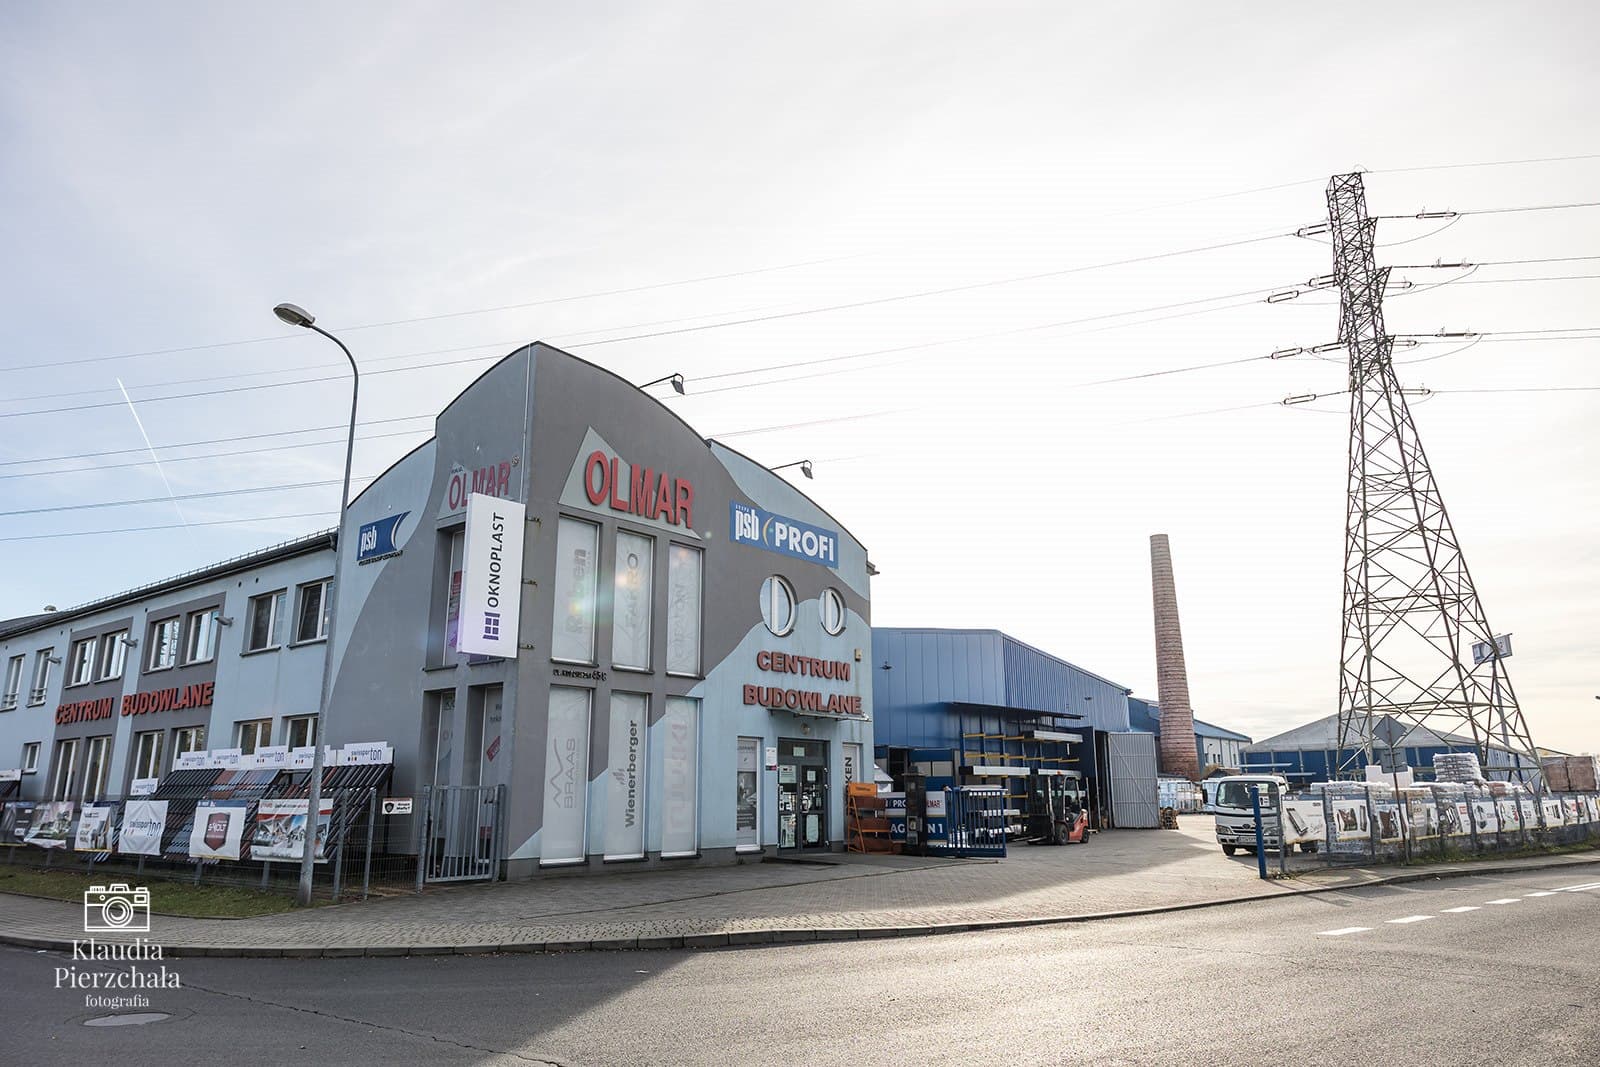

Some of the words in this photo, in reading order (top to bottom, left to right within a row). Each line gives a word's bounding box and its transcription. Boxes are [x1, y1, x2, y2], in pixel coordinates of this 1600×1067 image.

[448, 461, 511, 511] OLMAR
[585, 450, 695, 529] OLMAR
[360, 525, 378, 557] psb
[487, 511, 505, 608] OKNOPLAST
[735, 508, 760, 541] psb
[775, 521, 834, 562] PROFI
[757, 650, 850, 681] CENTRUM
[55, 697, 114, 725] CENTRUM
[121, 682, 214, 717] BUDOWLANE
[743, 683, 862, 715] BUDOWLANE
[563, 738, 576, 809] BRAAS
[625, 720, 639, 828] Wienerberger
